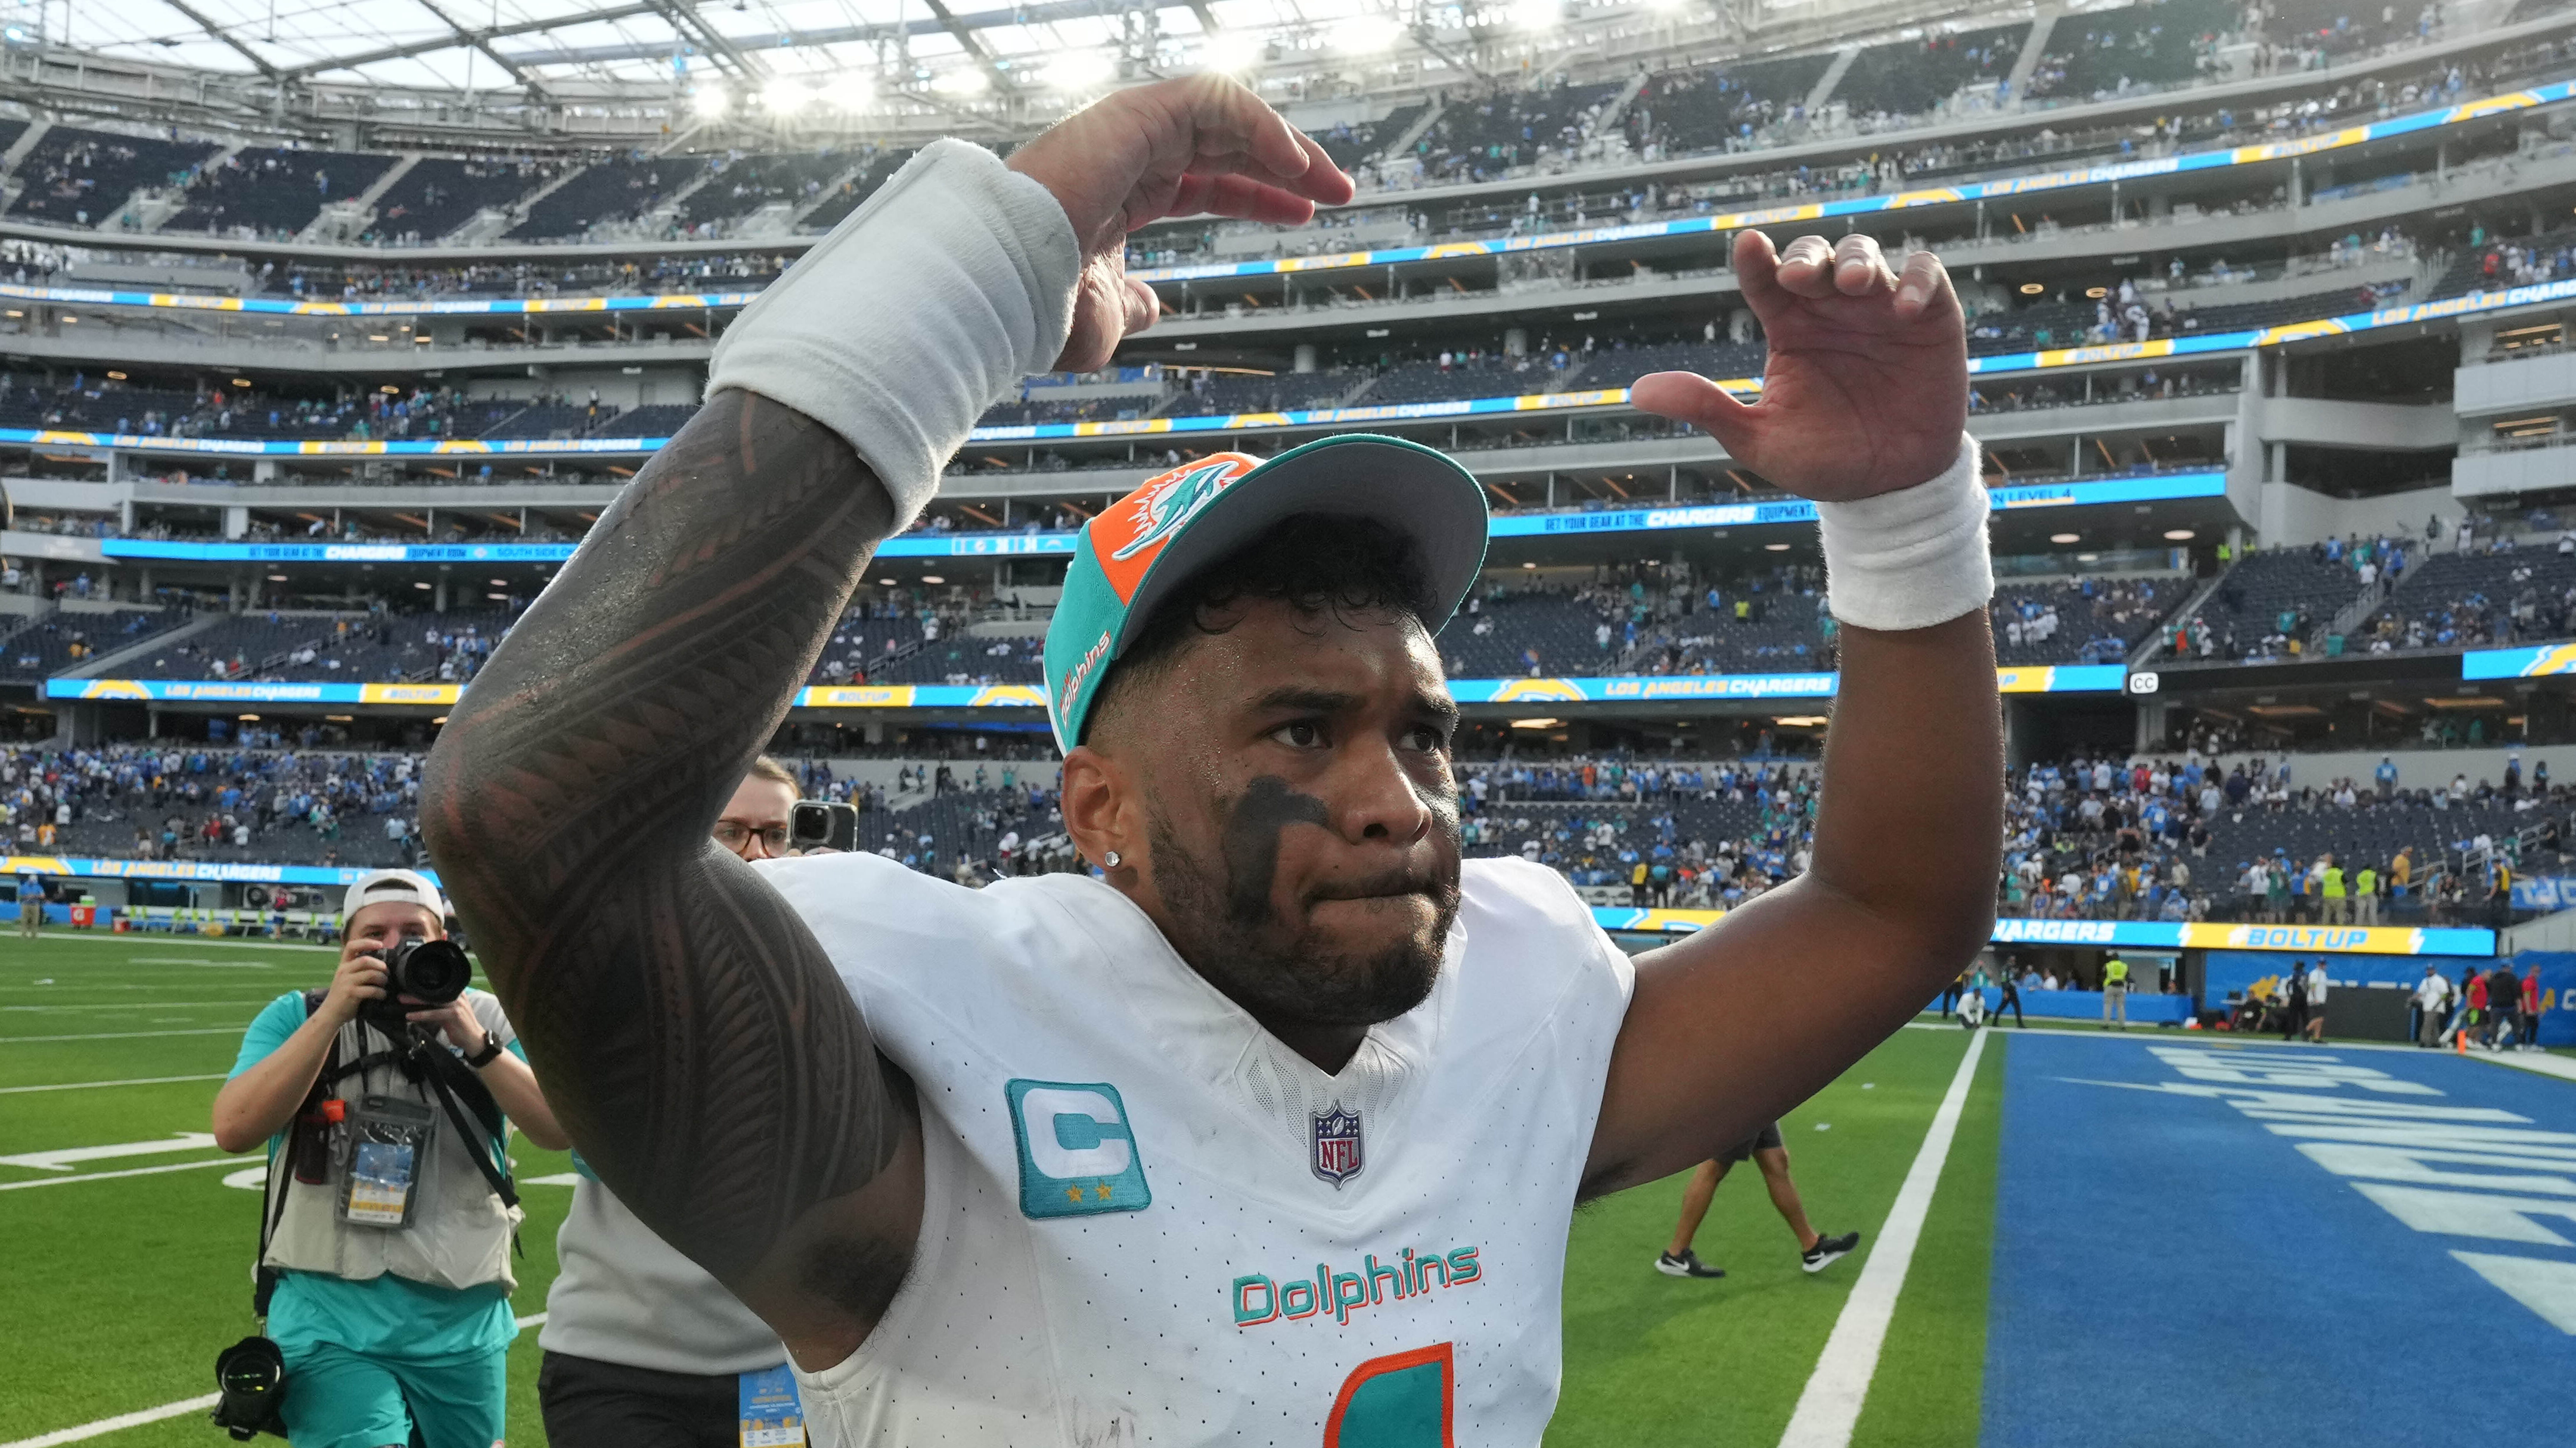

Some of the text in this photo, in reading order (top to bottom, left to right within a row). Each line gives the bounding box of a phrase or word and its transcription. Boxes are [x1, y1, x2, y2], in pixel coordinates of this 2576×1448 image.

[2372, 308, 2410, 326] LOS
[2413, 291, 2507, 322] ANGELES
[2009, 490, 2053, 501] LEVEL
[2063, 488, 2072, 497] 4
[1646, 506, 1757, 527] CHARGERS
[1605, 678, 1832, 699] LOS ANGELES CHARGERS
[2134, 677, 2154, 689] CC
[92, 861, 282, 881] LOS ANGELES CHARGERS
[1022, 1087, 1131, 1179] C
[1320, 1139, 1359, 1173] NFL
[1233, 1245, 1482, 1327] Dolphins
